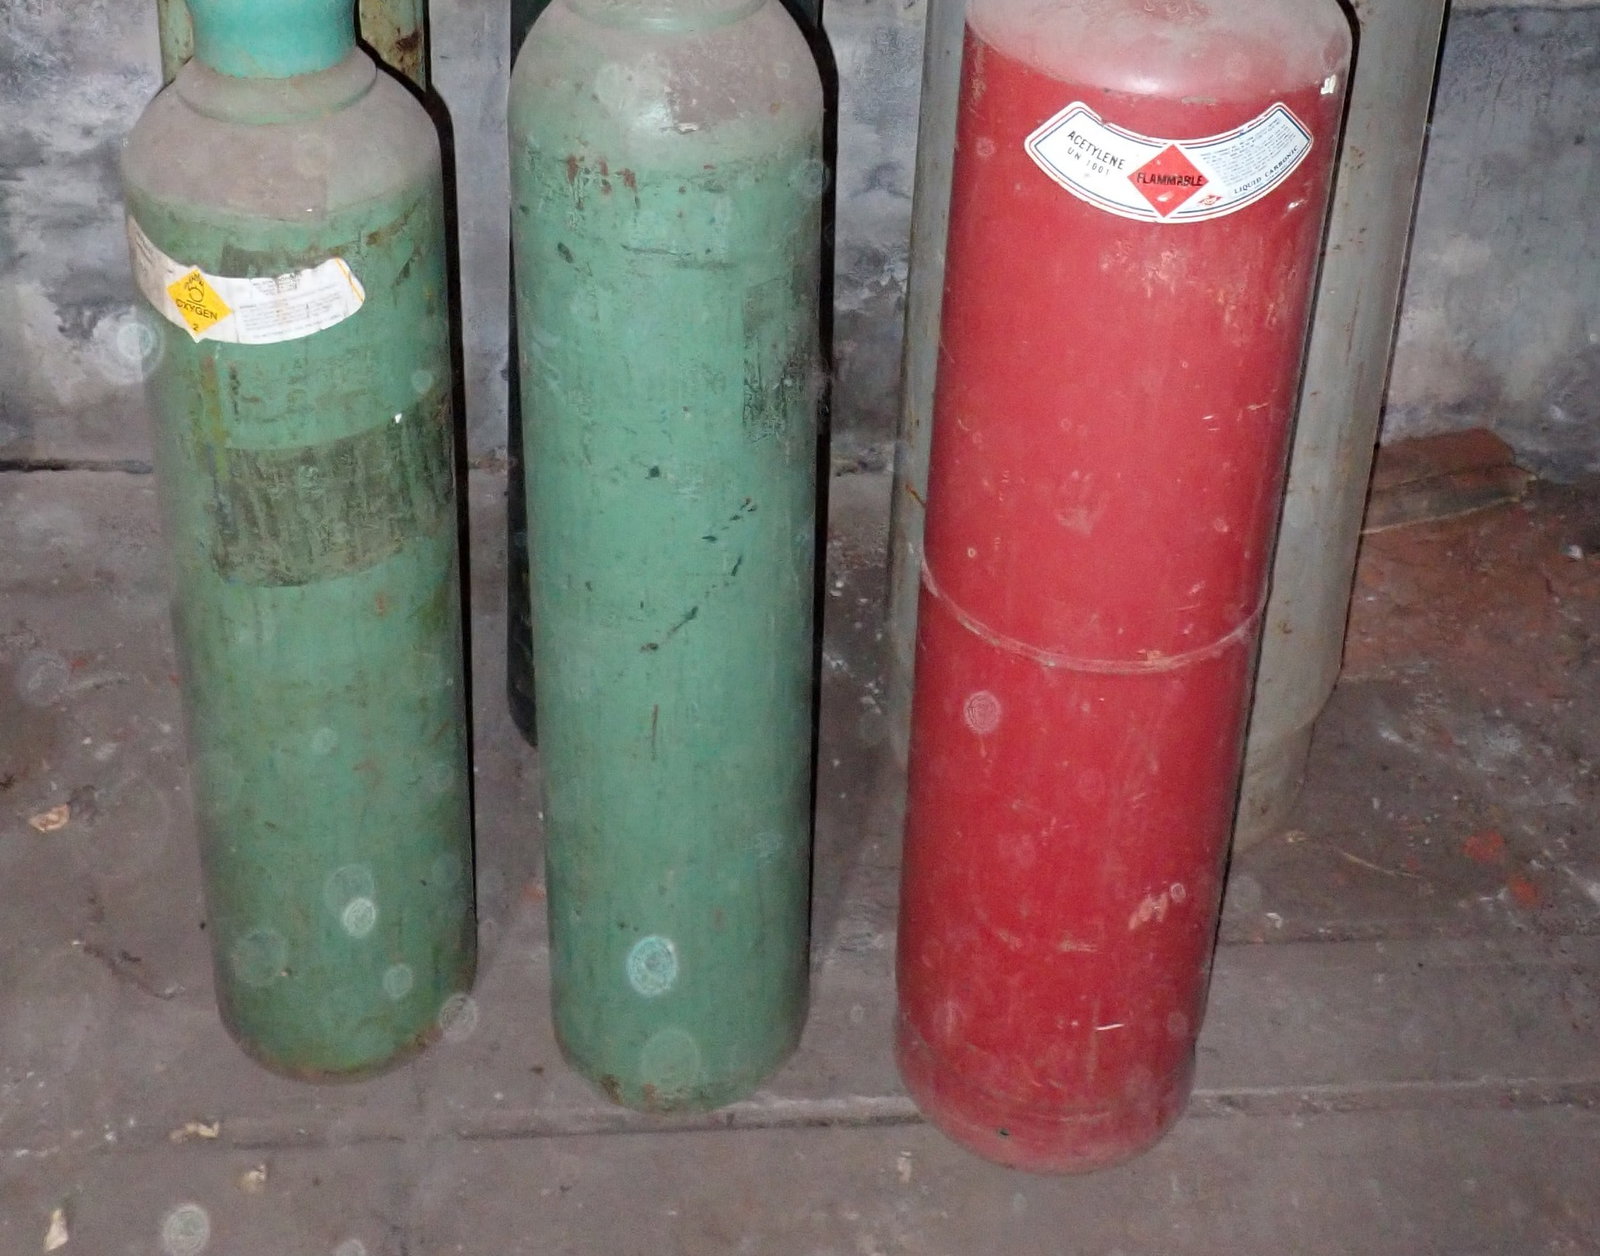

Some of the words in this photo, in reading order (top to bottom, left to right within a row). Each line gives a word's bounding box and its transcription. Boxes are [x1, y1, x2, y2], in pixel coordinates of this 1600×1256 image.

[1067, 130, 1125, 170] ACETYLENE
[1067, 146, 1081, 160] UN
[1086, 160, 1110, 175] 1001
[1136, 172, 1203, 187] FLAMMABLE
[1234, 176, 1262, 194] LIQUID
[176, 298, 218, 321] OXYGEN
